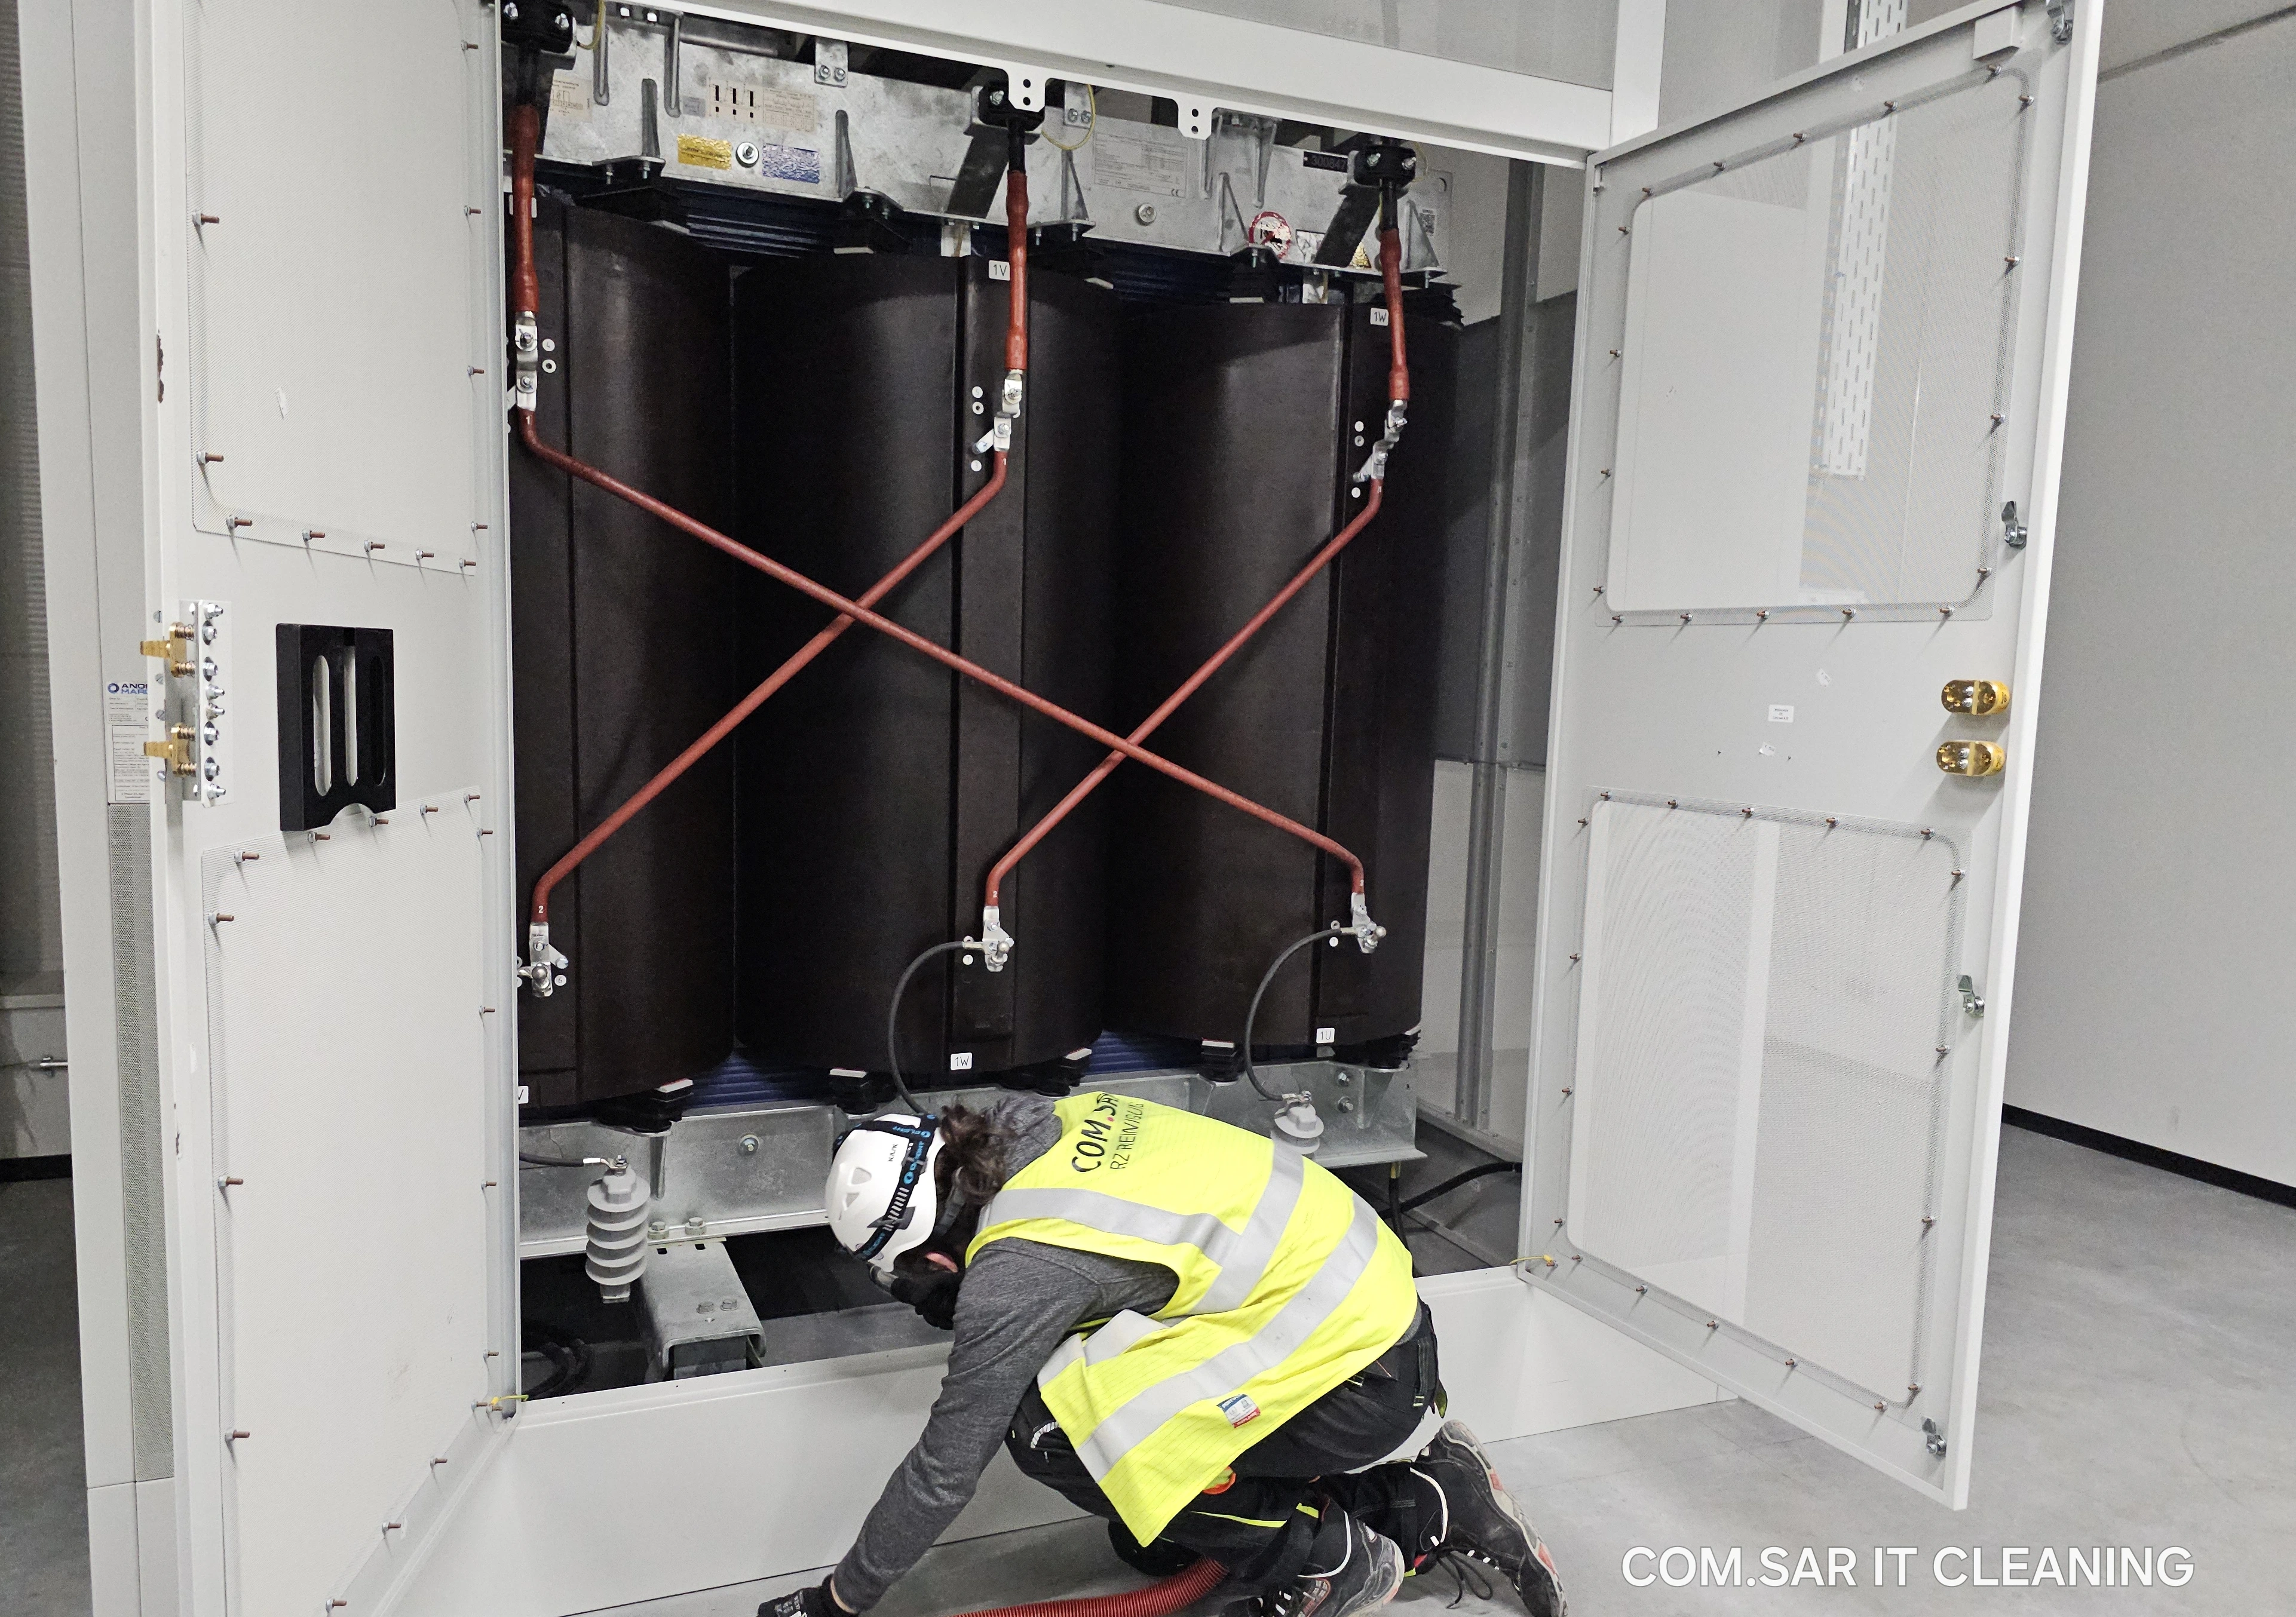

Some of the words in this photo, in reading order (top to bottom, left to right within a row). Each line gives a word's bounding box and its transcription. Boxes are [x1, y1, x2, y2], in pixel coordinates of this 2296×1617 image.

[993, 263, 1007, 277] 1V
[1374, 311, 1387, 323] 1W
[526, 415, 531, 425] 1
[992, 890, 998, 898] 2
[538, 905, 544, 913] 2
[1320, 1030, 1332, 1041] 1U
[955, 1056, 970, 1067] 1W
[1109, 1153, 1130, 1170] RZ
